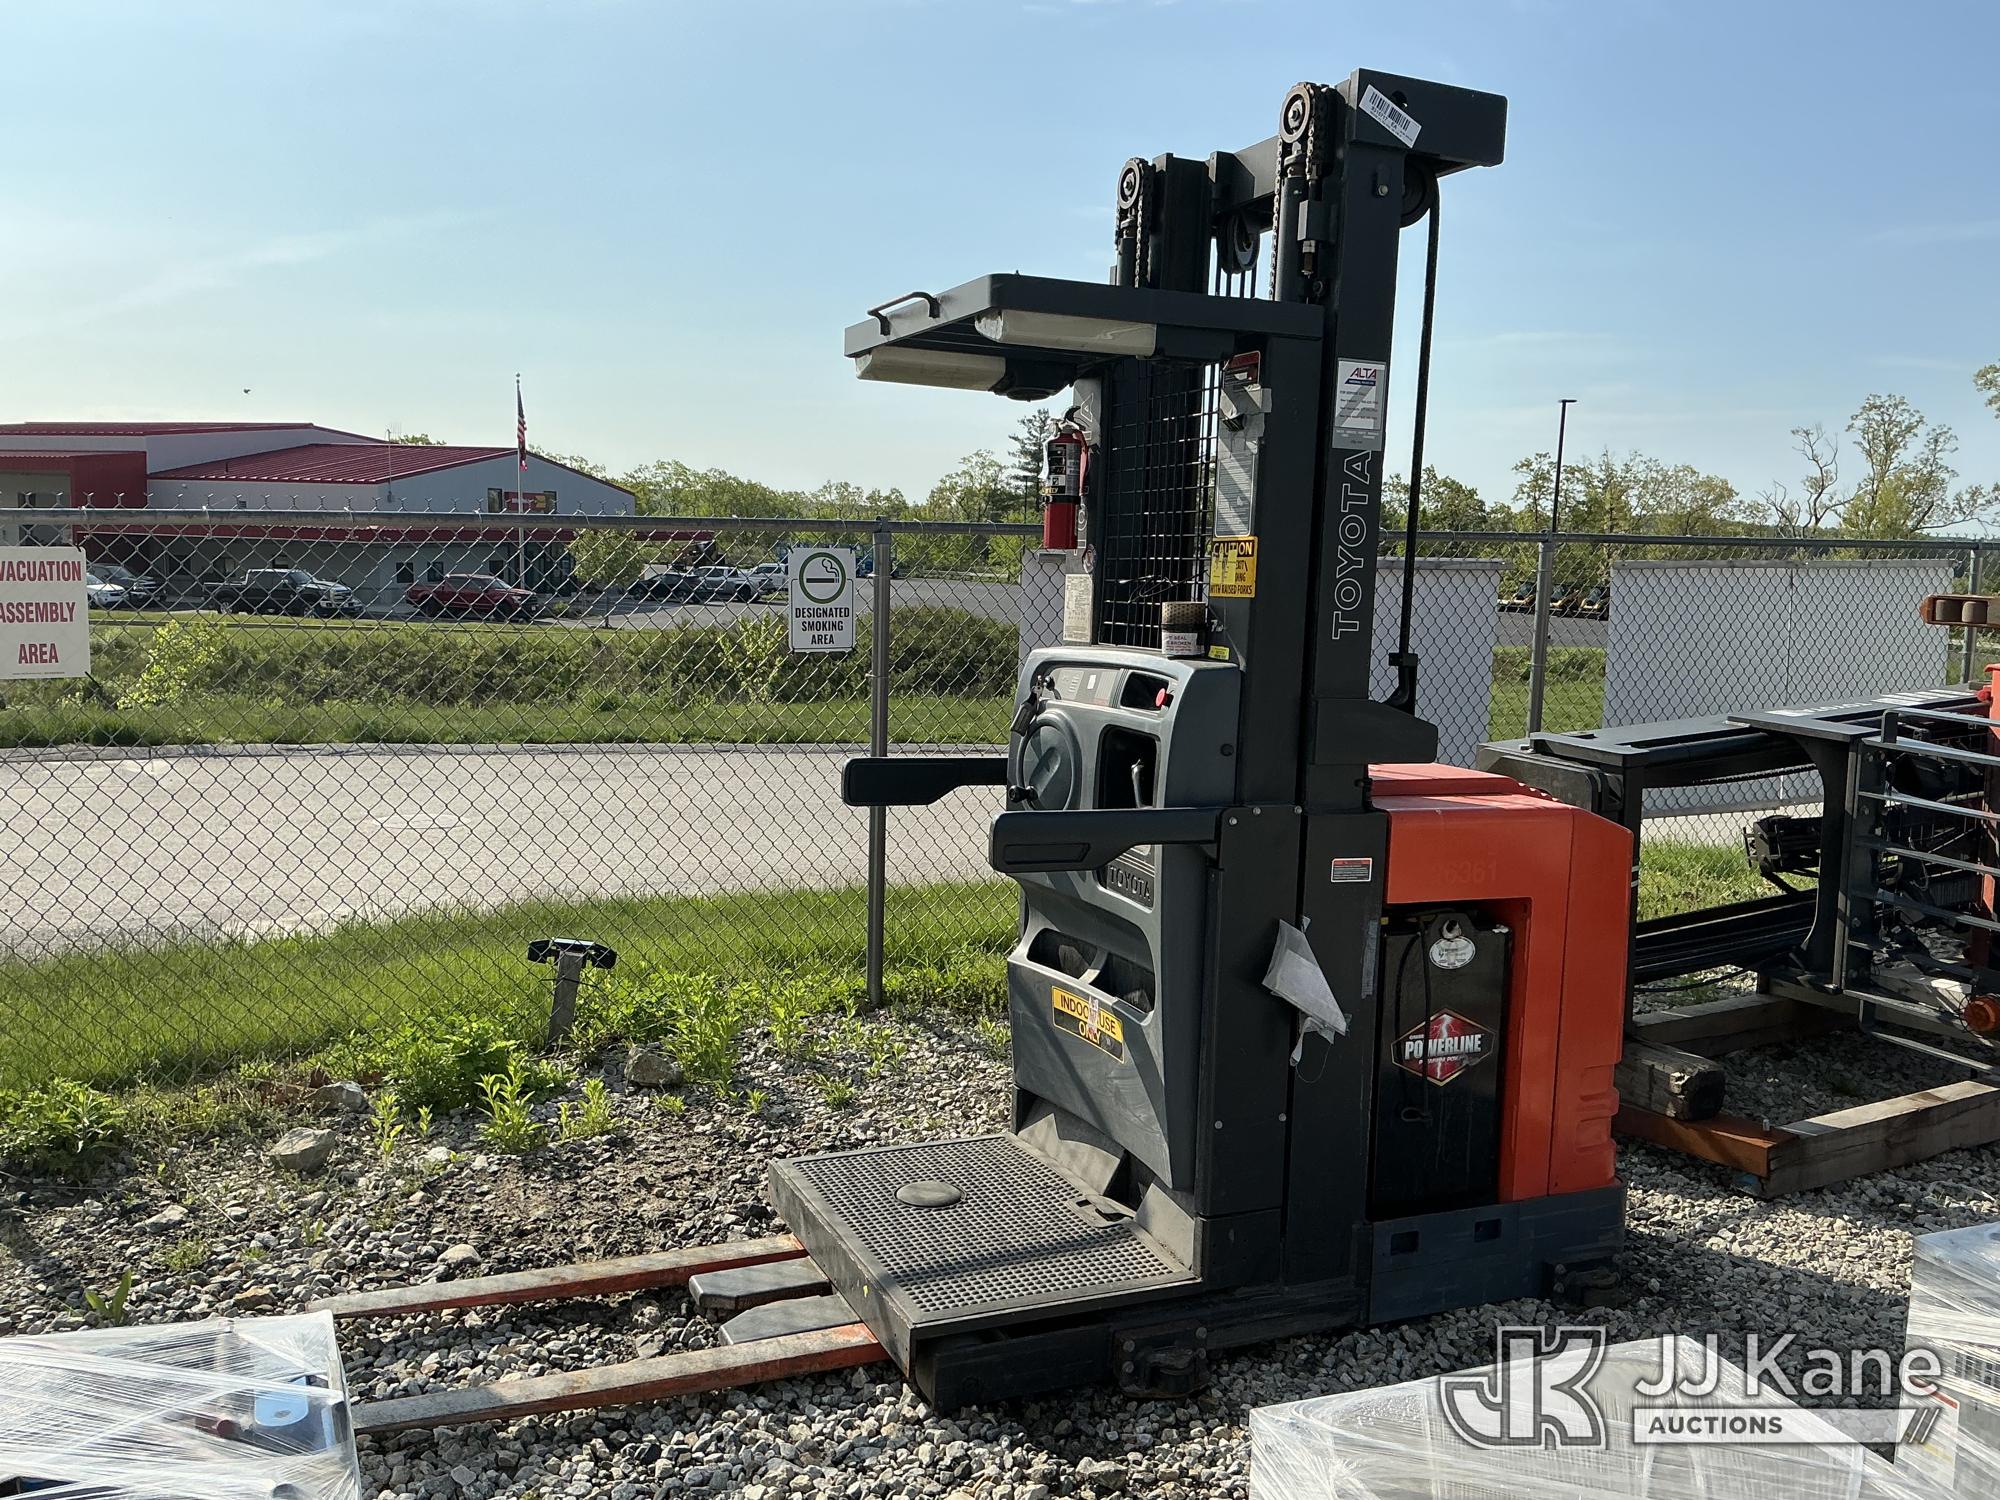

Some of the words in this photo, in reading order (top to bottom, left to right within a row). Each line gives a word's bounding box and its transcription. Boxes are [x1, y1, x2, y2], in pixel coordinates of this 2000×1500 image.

[1350, 367, 1377, 380] ALTA
[1331, 450, 1372, 640] TOYOTA
[795, 607, 850, 619] DESIGNATED
[801, 620, 844, 632] SMOKING
[811, 634, 835, 645] AREA
[18, 643, 59, 664] AREA
[1110, 867, 1151, 902] TOYOTA
[1099, 1010, 1116, 1036] USE
